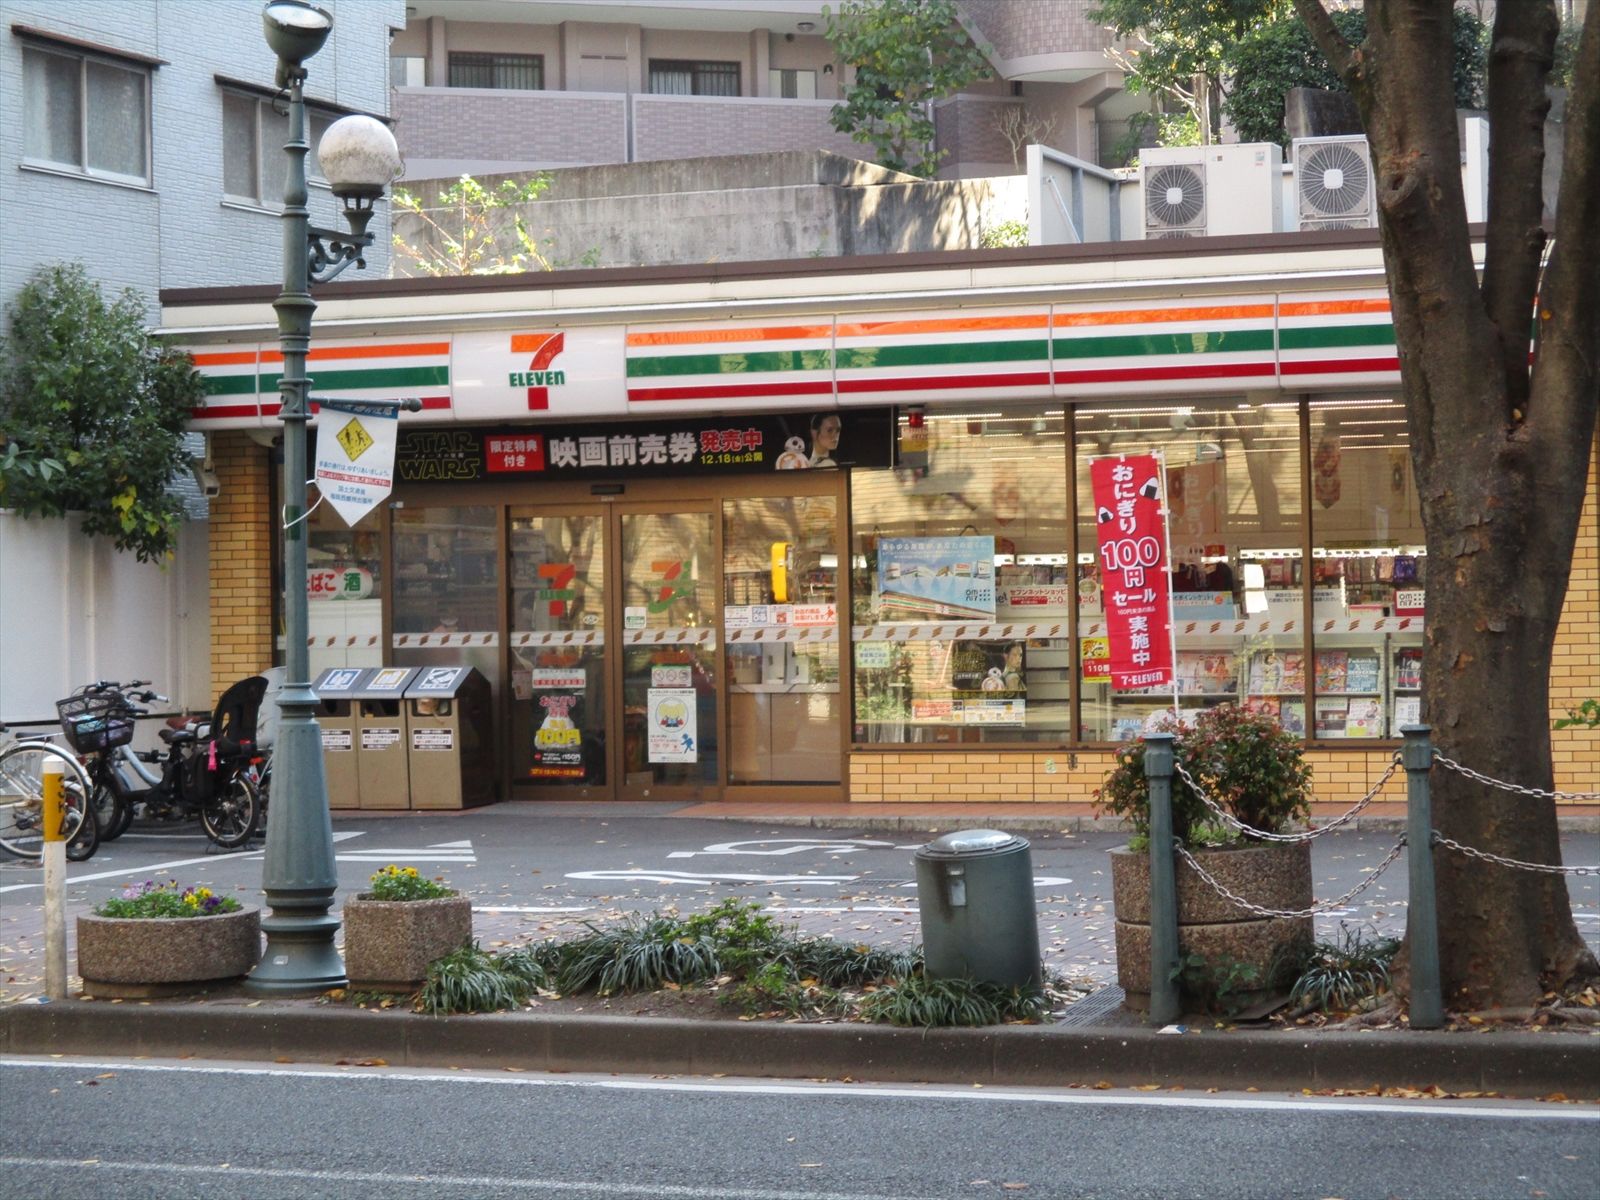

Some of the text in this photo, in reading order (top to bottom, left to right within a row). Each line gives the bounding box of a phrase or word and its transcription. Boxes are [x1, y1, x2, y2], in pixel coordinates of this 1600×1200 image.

[510, 332, 564, 410] 7
[397, 431, 479, 453] STAR
[490, 440, 537, 453] 限定特典
[549, 432, 697, 467] 映画前売券
[700, 428, 763, 453] 発売中
[399, 458, 480, 480] WARS
[504, 455, 526, 467] 付き
[1112, 464, 1137, 534] おにぎり
[344, 573, 360, 591] 酒
[1113, 588, 1156, 606] セール
[1129, 616, 1151, 666] 実施中
